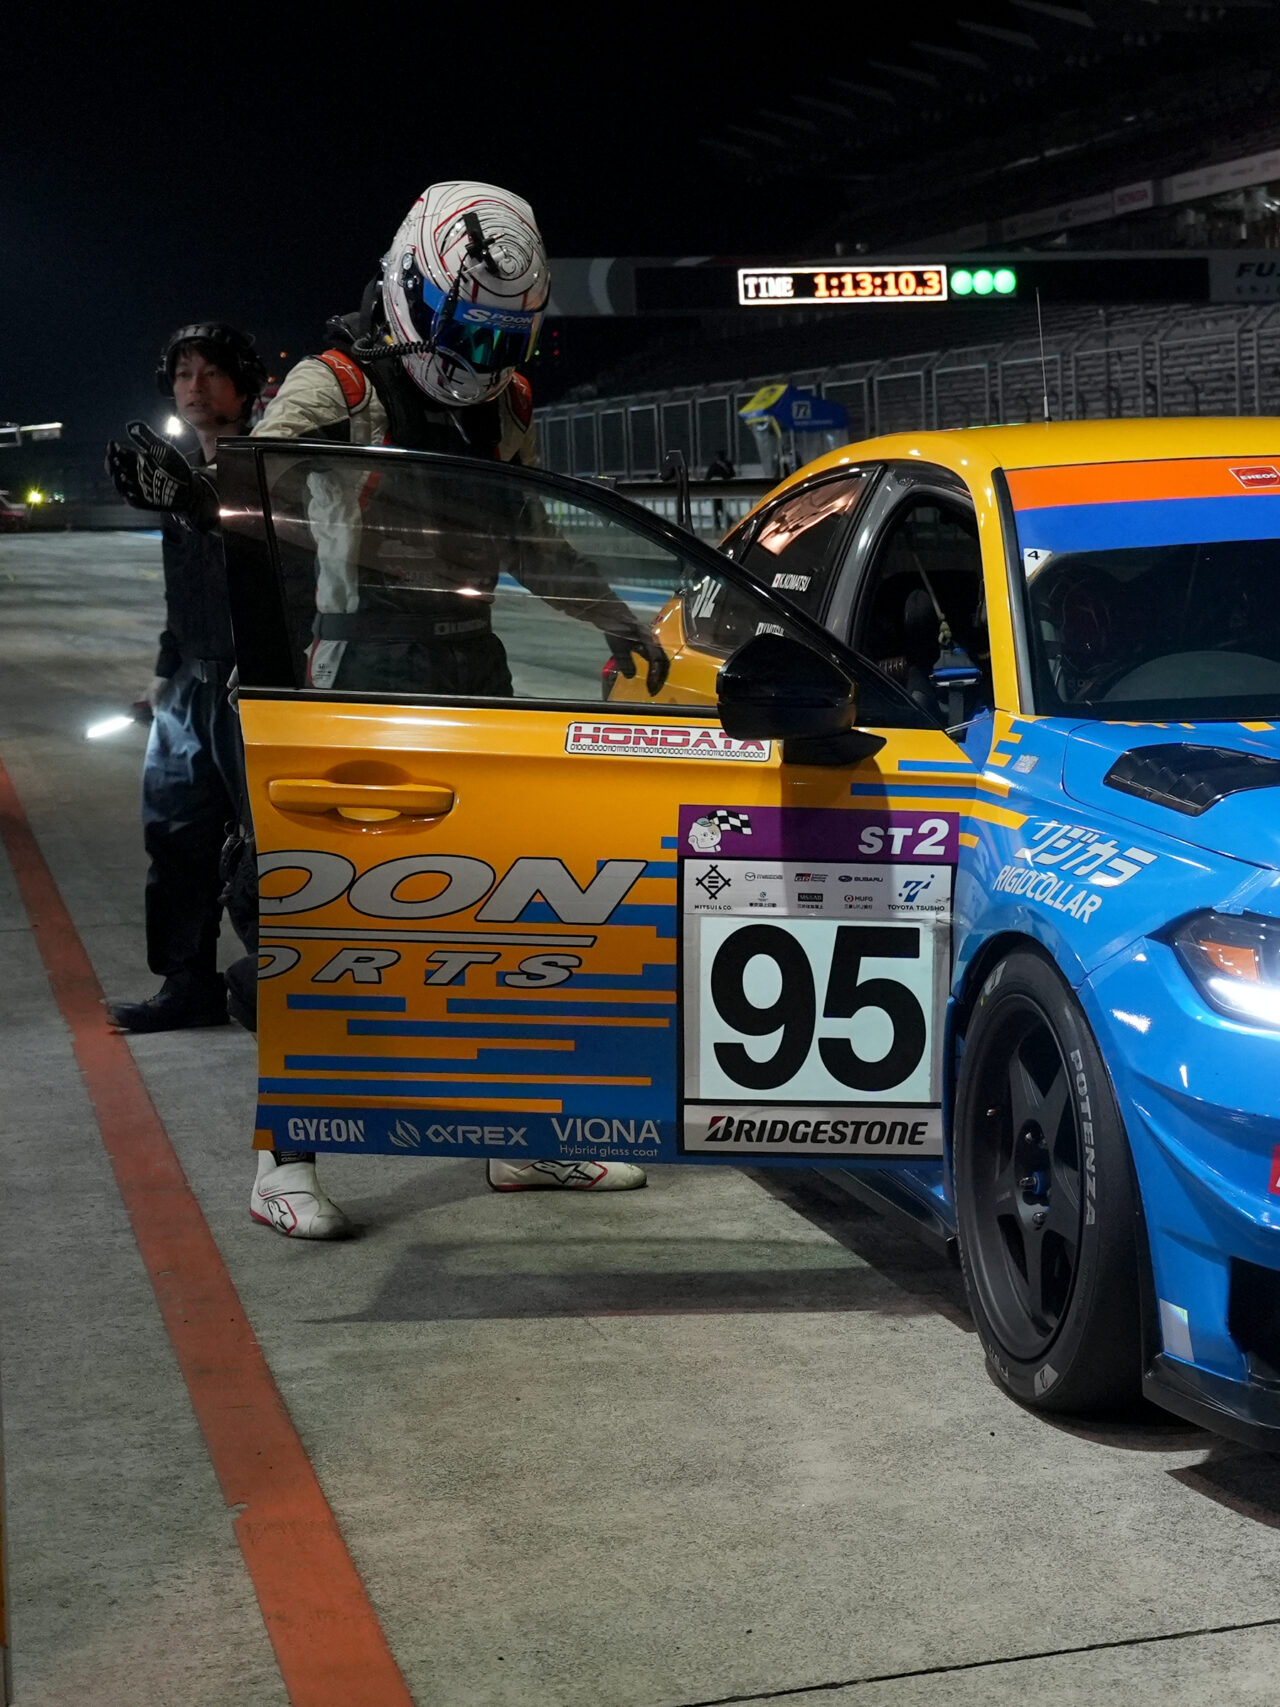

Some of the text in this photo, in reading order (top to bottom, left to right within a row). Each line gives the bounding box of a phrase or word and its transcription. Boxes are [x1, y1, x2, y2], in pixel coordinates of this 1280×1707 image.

[745, 271, 941, 298] TIME 1:13:10.3
[463, 309, 532, 323] SPOON
[1240, 473, 1278, 481] ENEOS
[1028, 550, 1040, 560] 4
[572, 726, 766, 751] HONDATA
[858, 819, 949, 855] ST2
[992, 864, 1102, 924] RIGIDCOLLAR
[711, 924, 926, 1091] 95
[287, 1118, 365, 1142] GYEON
[705, 1116, 928, 1145] BRIDGESTONE
[1069, 1048, 1095, 1226] POTENZA
[560, 1144, 658, 1157] Hybrid glass coat
